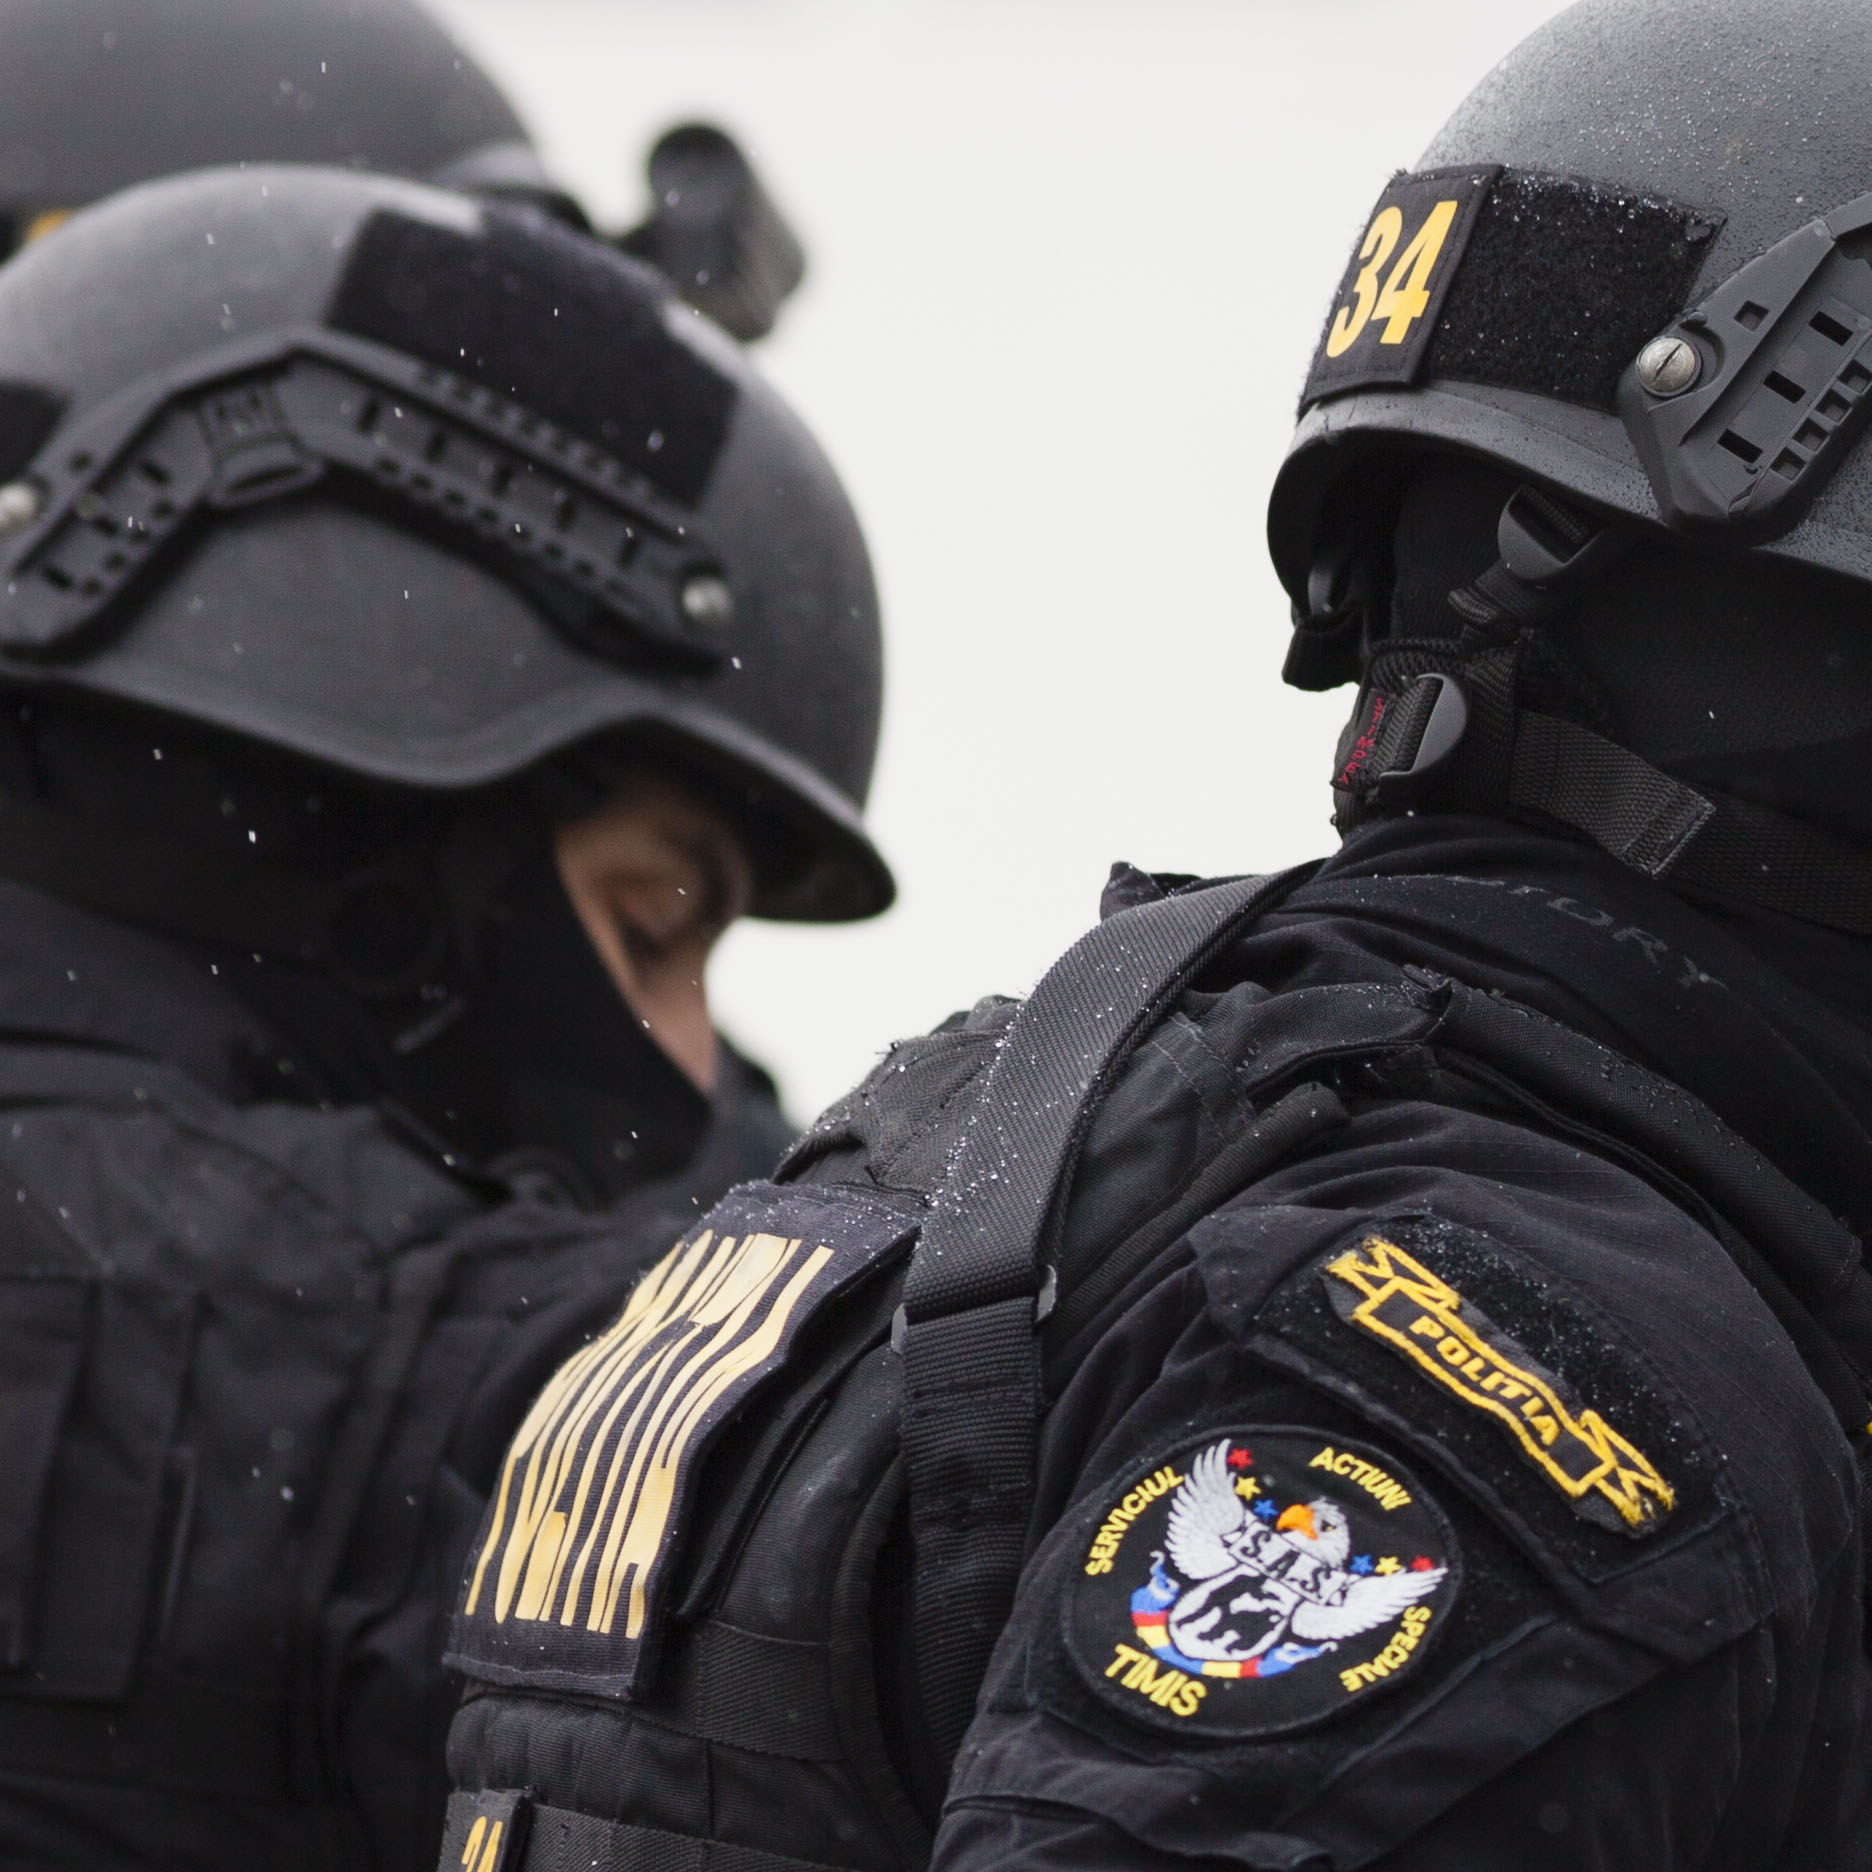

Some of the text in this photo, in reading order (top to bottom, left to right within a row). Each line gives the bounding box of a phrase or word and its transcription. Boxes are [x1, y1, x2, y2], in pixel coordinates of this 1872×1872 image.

[1327, 200, 1458, 357] 34
[1408, 1315, 1562, 1446] POLITIA
[1085, 1447, 1431, 1691] SERVICIUL ACTIUNI SPECIALE
[1105, 1644, 1206, 1716] TIMIS
